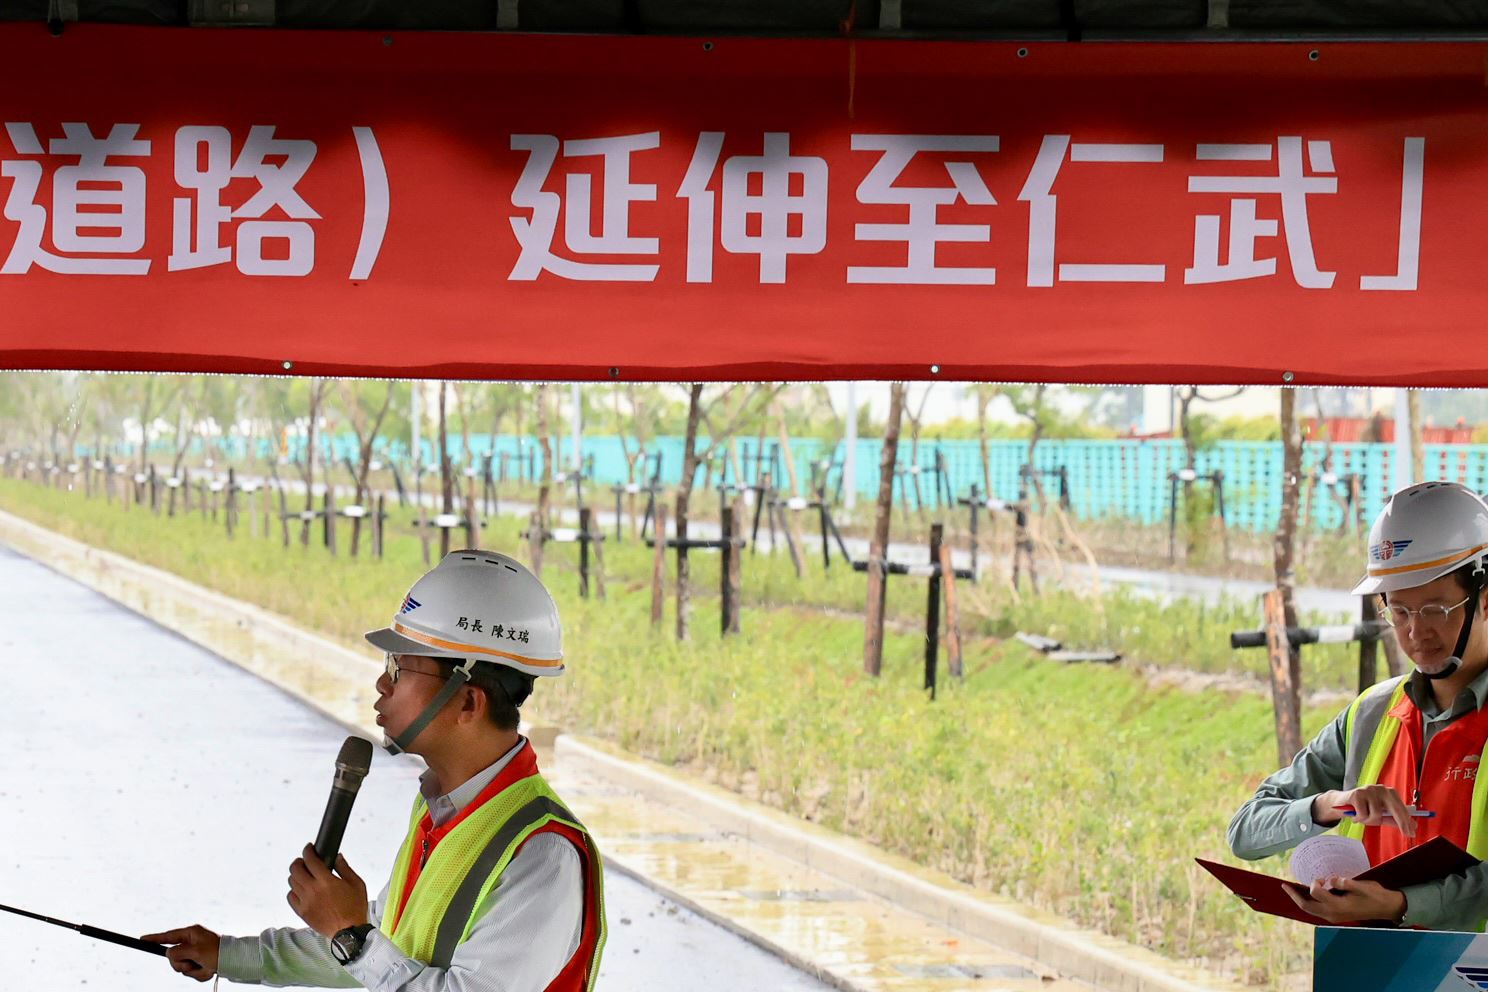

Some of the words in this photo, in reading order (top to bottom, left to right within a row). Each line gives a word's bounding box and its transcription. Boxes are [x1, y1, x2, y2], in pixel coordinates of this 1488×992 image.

[455, 616, 483, 633] 局長
[491, 624, 530, 644] 陳文瑞
